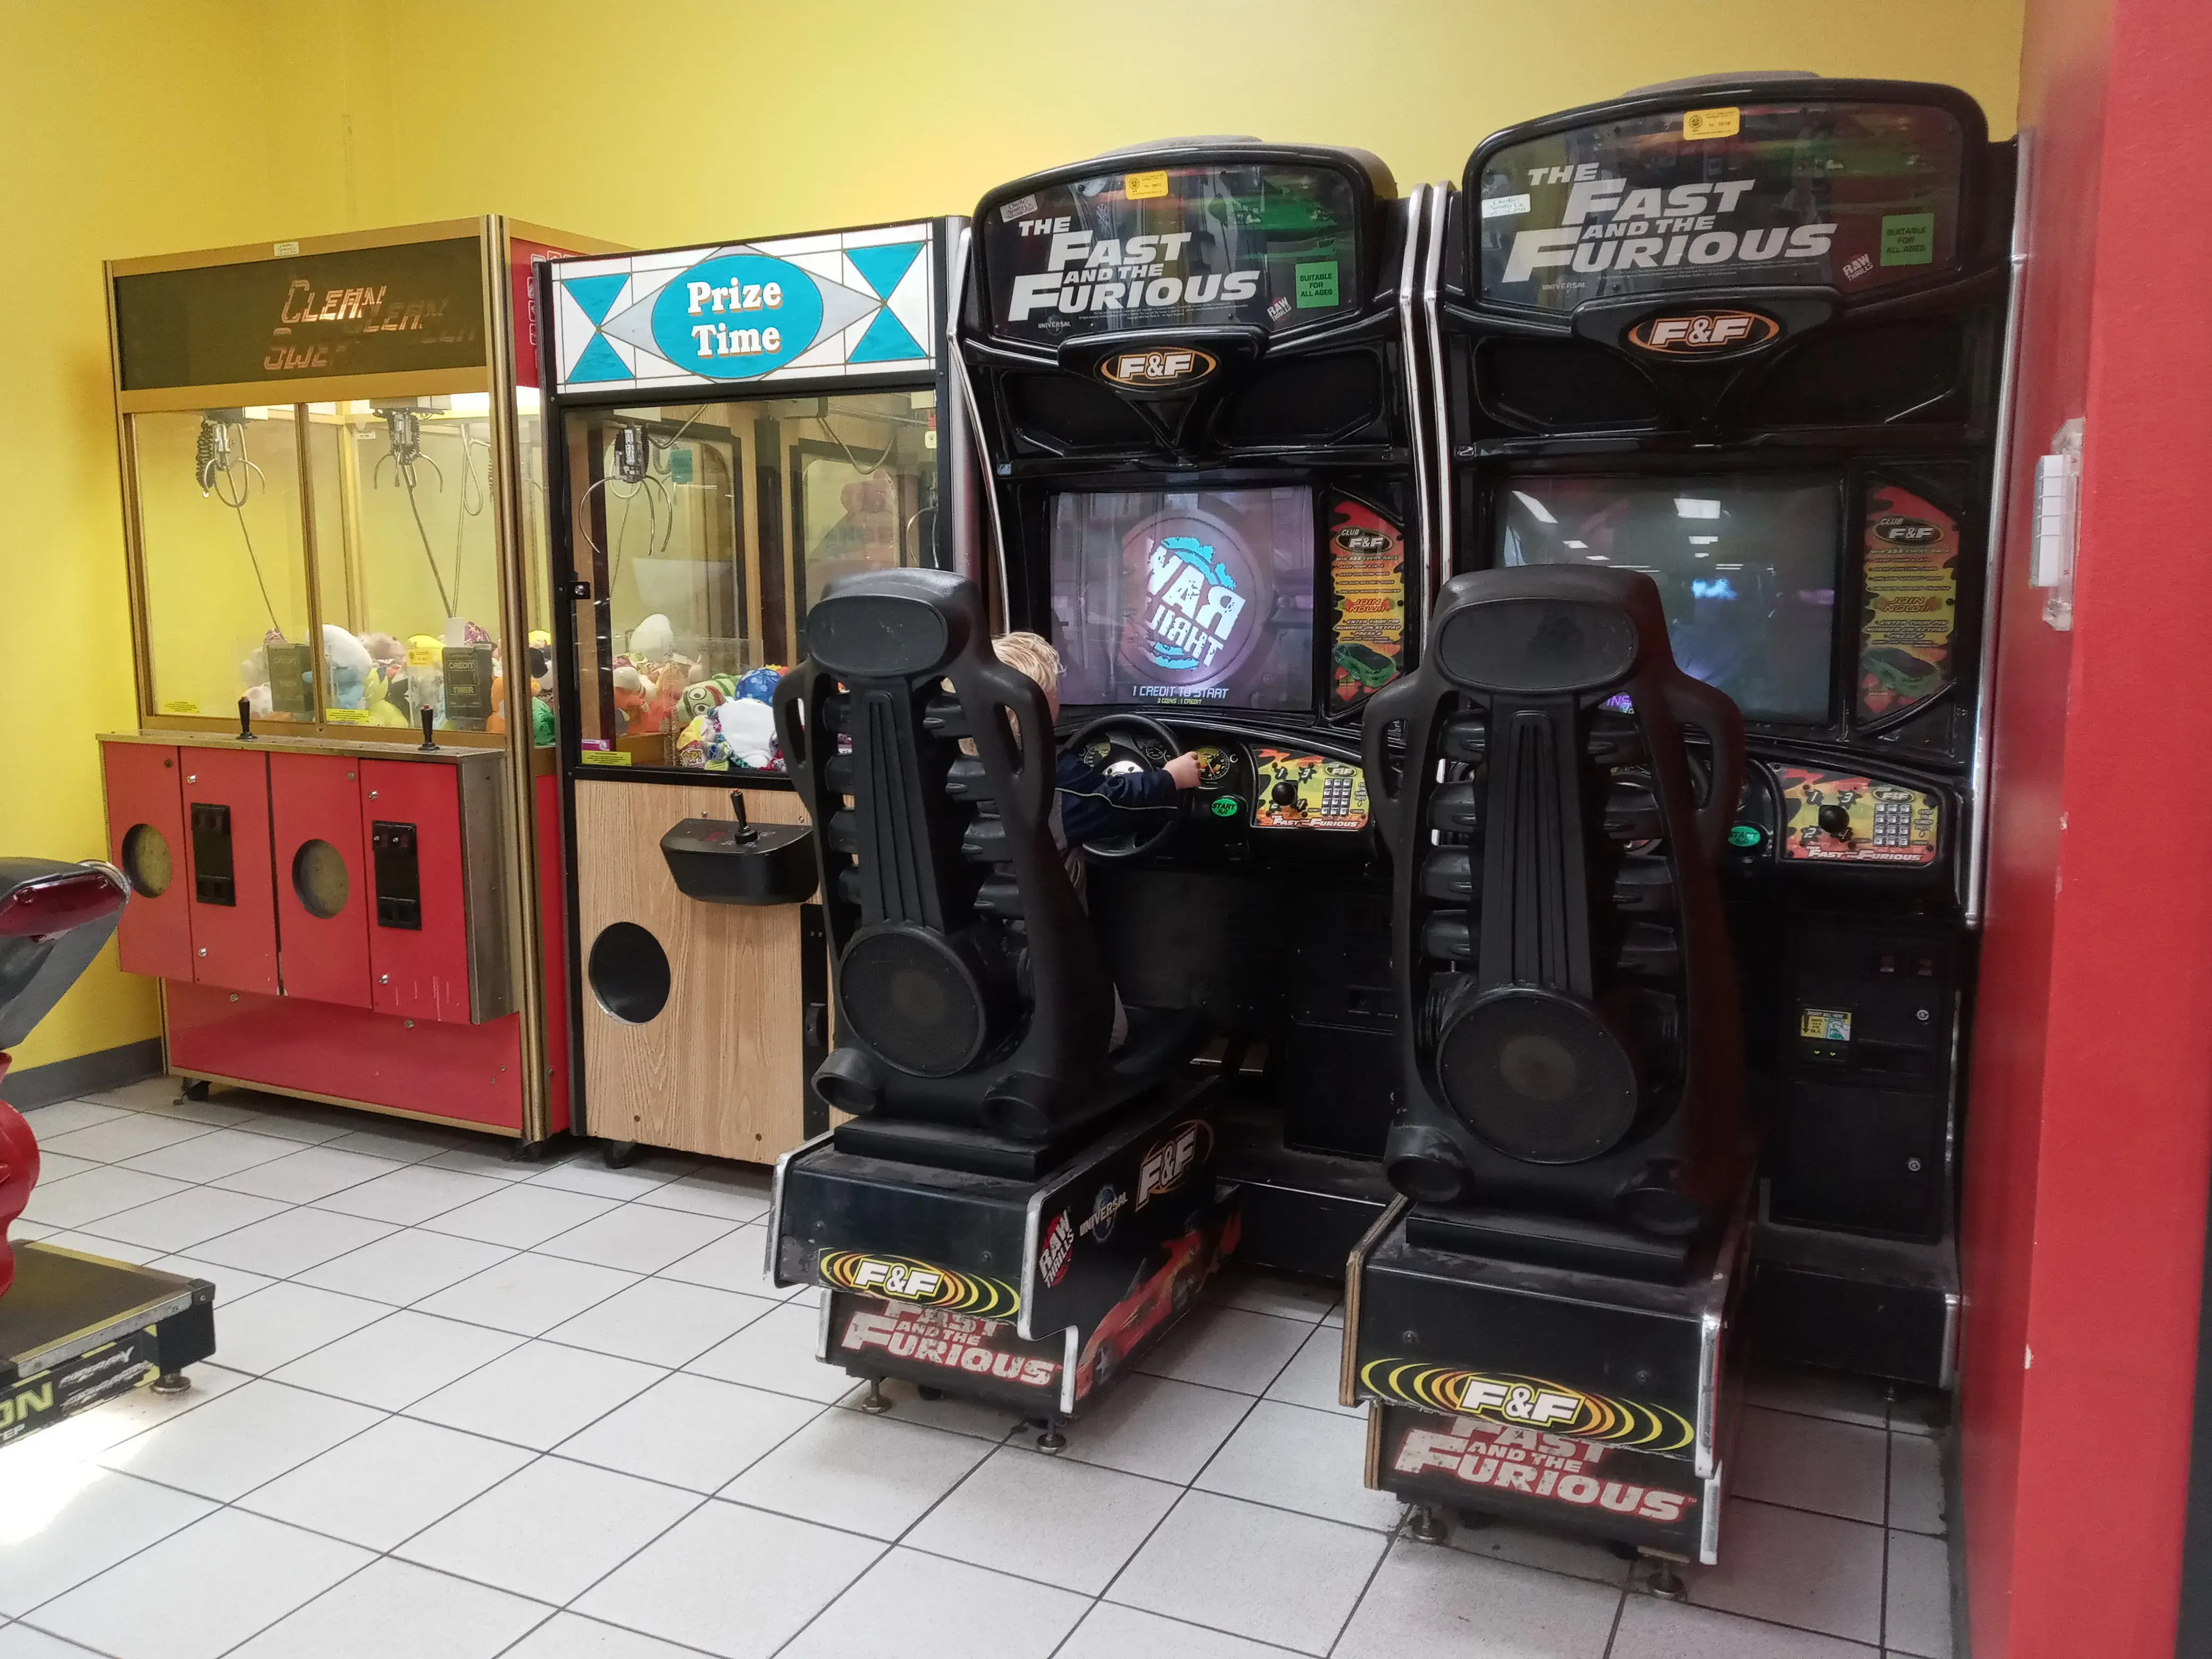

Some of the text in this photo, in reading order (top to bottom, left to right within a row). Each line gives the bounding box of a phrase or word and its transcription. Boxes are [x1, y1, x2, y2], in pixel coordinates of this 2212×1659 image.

[1528, 163, 1599, 186] THE
[1562, 178, 1755, 225] FAST
[1019, 216, 1071, 237] THE
[1582, 215, 1716, 239] AND THE
[1048, 230, 1192, 271] FAST
[1502, 223, 1839, 283] FURIOUS
[1063, 263, 1164, 284] AND THE
[1300, 273, 1333, 282] SUITABLE
[686, 277, 783, 315] Prize
[1008, 270, 1261, 322] FURIOUS
[1541, 282, 1587, 291] UNIVERSAL
[1267, 296, 1289, 317] RAW
[1270, 304, 1292, 322] THRILLS
[691, 322, 782, 357] Time
[1649, 316, 1751, 346] F&F
[1119, 353, 1192, 379] F&F
[1348, 537, 1384, 548] F&F
[1888, 527, 1934, 539] F&F
[448, 661, 474, 670] CREDIT
[1132, 685, 1229, 699] 1 CREDIT TO START
[1278, 768, 1285, 777] 1
[1301, 768, 1311, 778] 3
[1809, 792, 1818, 802] 1
[1841, 792, 1854, 803] 3
[1309, 817, 1359, 827] FURIOUS
[1804, 827, 1817, 839] 2
[1808, 849, 1845, 858] FAST
[1857, 850, 1922, 861] FURIOUS
[1138, 1128, 1196, 1206] F&F
[1079, 1192, 1128, 1237] UNIVERSAL
[1038, 1209, 1070, 1279] RAW
[1043, 1228, 1075, 1289] THRILLS
[853, 1260, 941, 1296] F&F
[896, 1322, 981, 1345] AND THE
[841, 1311, 1055, 1386] FURIOUS
[1460, 1379, 1582, 1424] F&F
[1467, 1440, 1583, 1473] AND THE
[1394, 1428, 1688, 1521] FURIOUS
